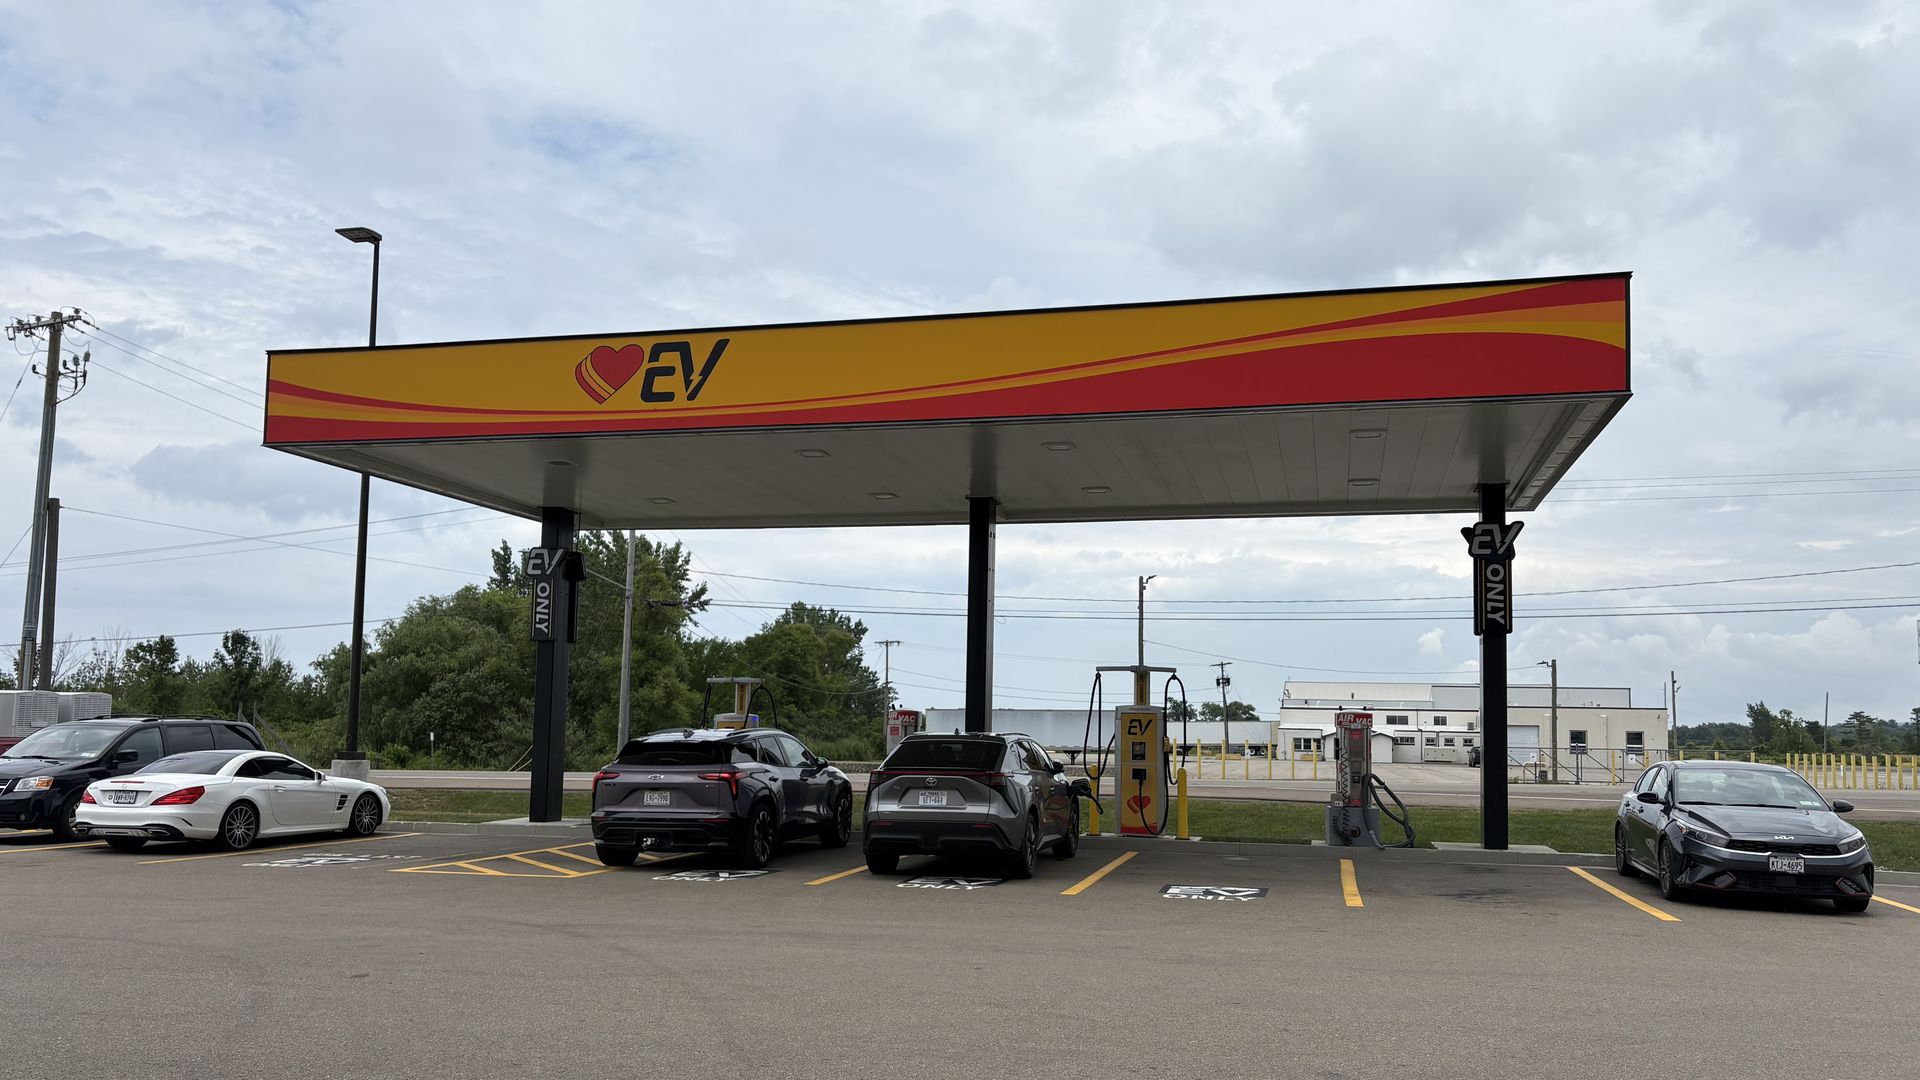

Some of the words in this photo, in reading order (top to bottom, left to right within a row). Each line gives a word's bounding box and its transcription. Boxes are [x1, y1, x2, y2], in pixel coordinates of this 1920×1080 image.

[641, 338, 730, 403] EV
[1471, 523, 1522, 554] EV
[527, 548, 564, 575] EV
[1486, 563, 1505, 625] ONLY
[535, 582, 550, 634] ONLY
[898, 714, 915, 722] VAC
[1128, 718, 1153, 736] EV
[1338, 713, 1355, 722] AIR
[1355, 717, 1371, 726] VAC
[1162, 893, 1257, 902] ONLY
